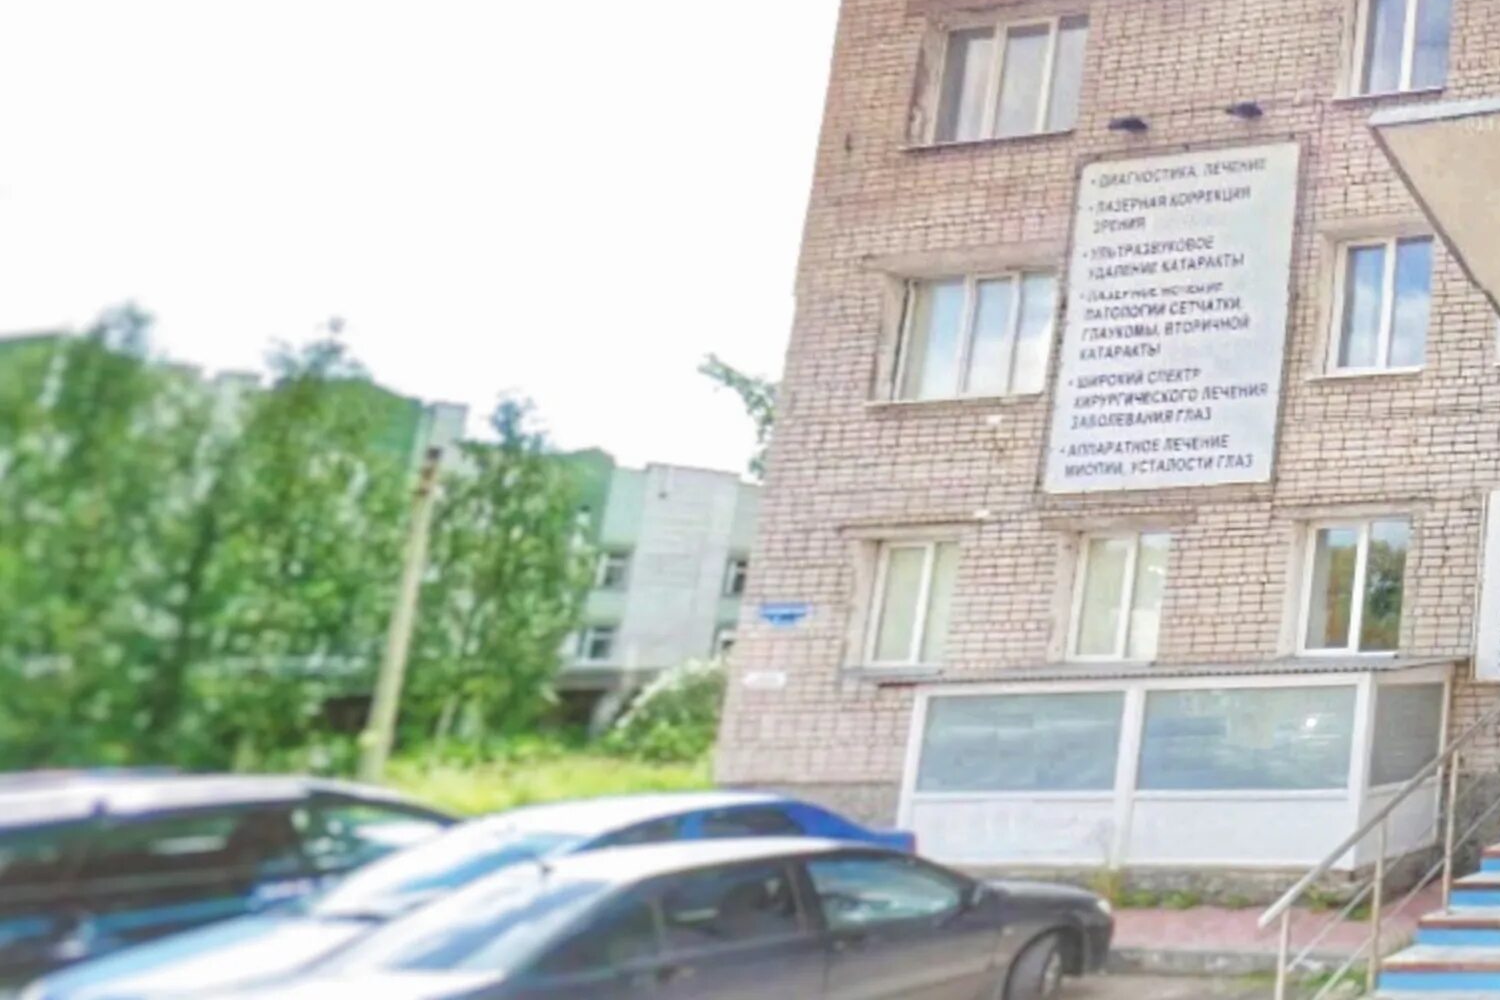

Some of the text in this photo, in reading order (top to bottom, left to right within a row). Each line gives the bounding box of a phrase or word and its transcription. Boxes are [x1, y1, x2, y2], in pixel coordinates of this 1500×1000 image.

[1203, 157, 1268, 177] ЛЕЧЕНИЕ
[1095, 186, 1252, 214] ЛАЗЕРНАЯ КОРРЕКЦИЯ
[1093, 216, 1147, 235] ЗРЕНИЯ
[1089, 235, 1216, 260] УЛЬТРАЗВУКОВОЕ
[1088, 253, 1245, 281] УДАЛЕНИЕ КАТАРАКТЫ
[1084, 302, 1166, 321] ПАТОЛОГИИ
[1164, 314, 1251, 336] ВТОРИЧНОЙ
[1078, 342, 1162, 361] КАТАРАКТЫ
[1076, 367, 1202, 389] ШИРОКИЙ СПЕКТР
[1072, 382, 1269, 409] ХИРУРГИЧЕСКОГО ЛЕЧЕНИЯ
[1070, 406, 1213, 430] ЗАБОЛЕВАНИЯ ГЛАЗ
[1066, 434, 1231, 458] АППАРАТНОЕ ЛЕЧЕНИЕ
[1130, 455, 1213, 475] УСТАЛОСТИ
[1215, 452, 1255, 470] ГЛАЗ
